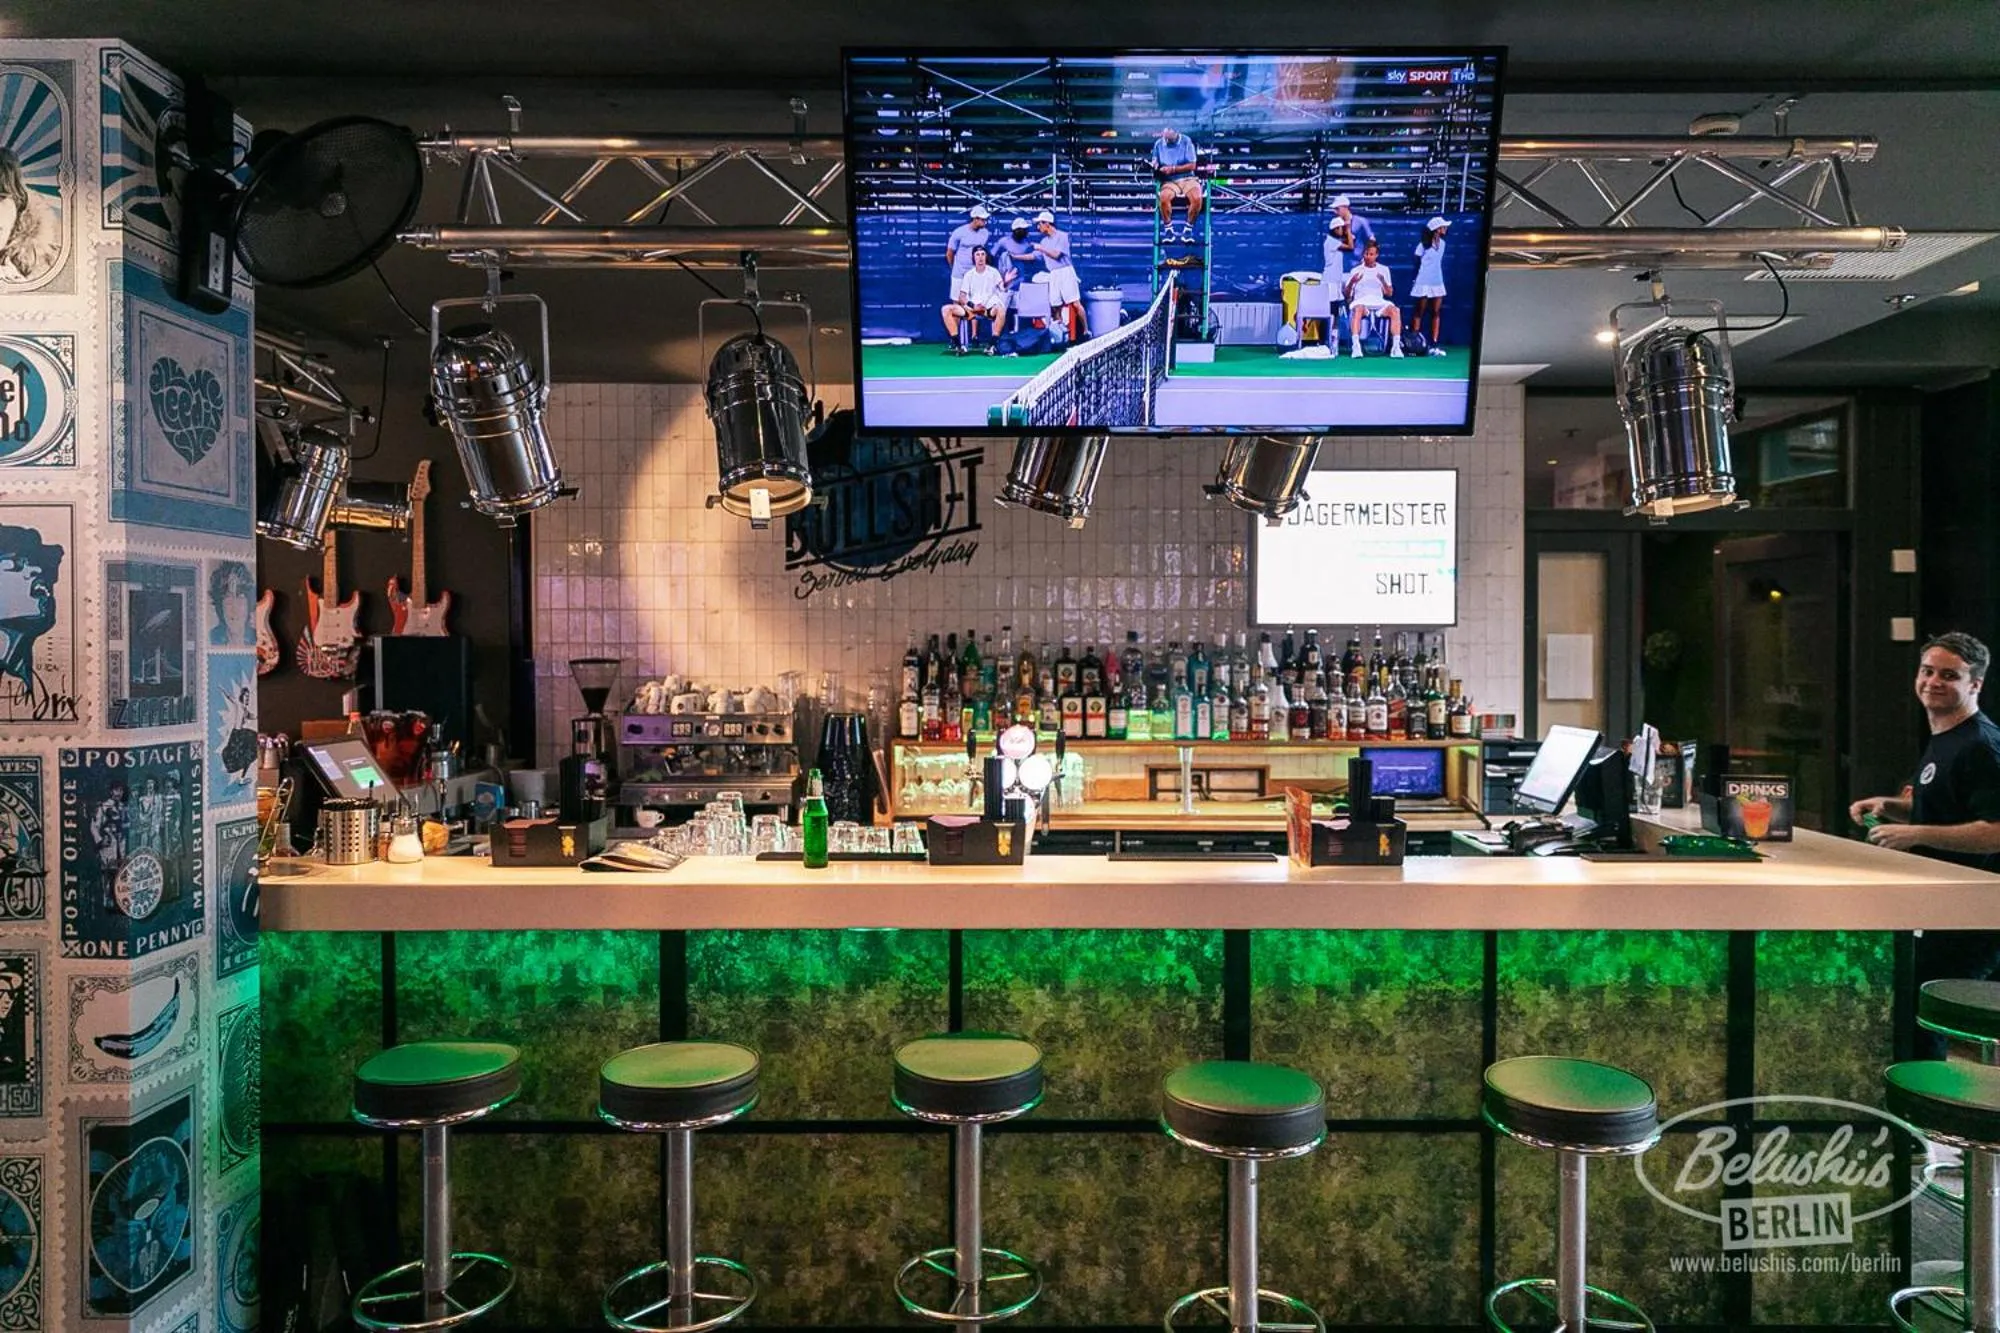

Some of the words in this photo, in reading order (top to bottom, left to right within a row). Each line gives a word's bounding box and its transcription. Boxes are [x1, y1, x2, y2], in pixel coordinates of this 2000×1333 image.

[1387, 69, 1406, 83] sky
[1409, 70, 1449, 81] SPORT
[63, 778, 78, 861] OFFICE
[191, 763, 203, 909] MAURITIUS
[64, 870, 79, 936] POST
[83, 939, 129, 957] ONE
[136, 922, 193, 954] PENNY
[13, 1090, 31, 1105] 50
